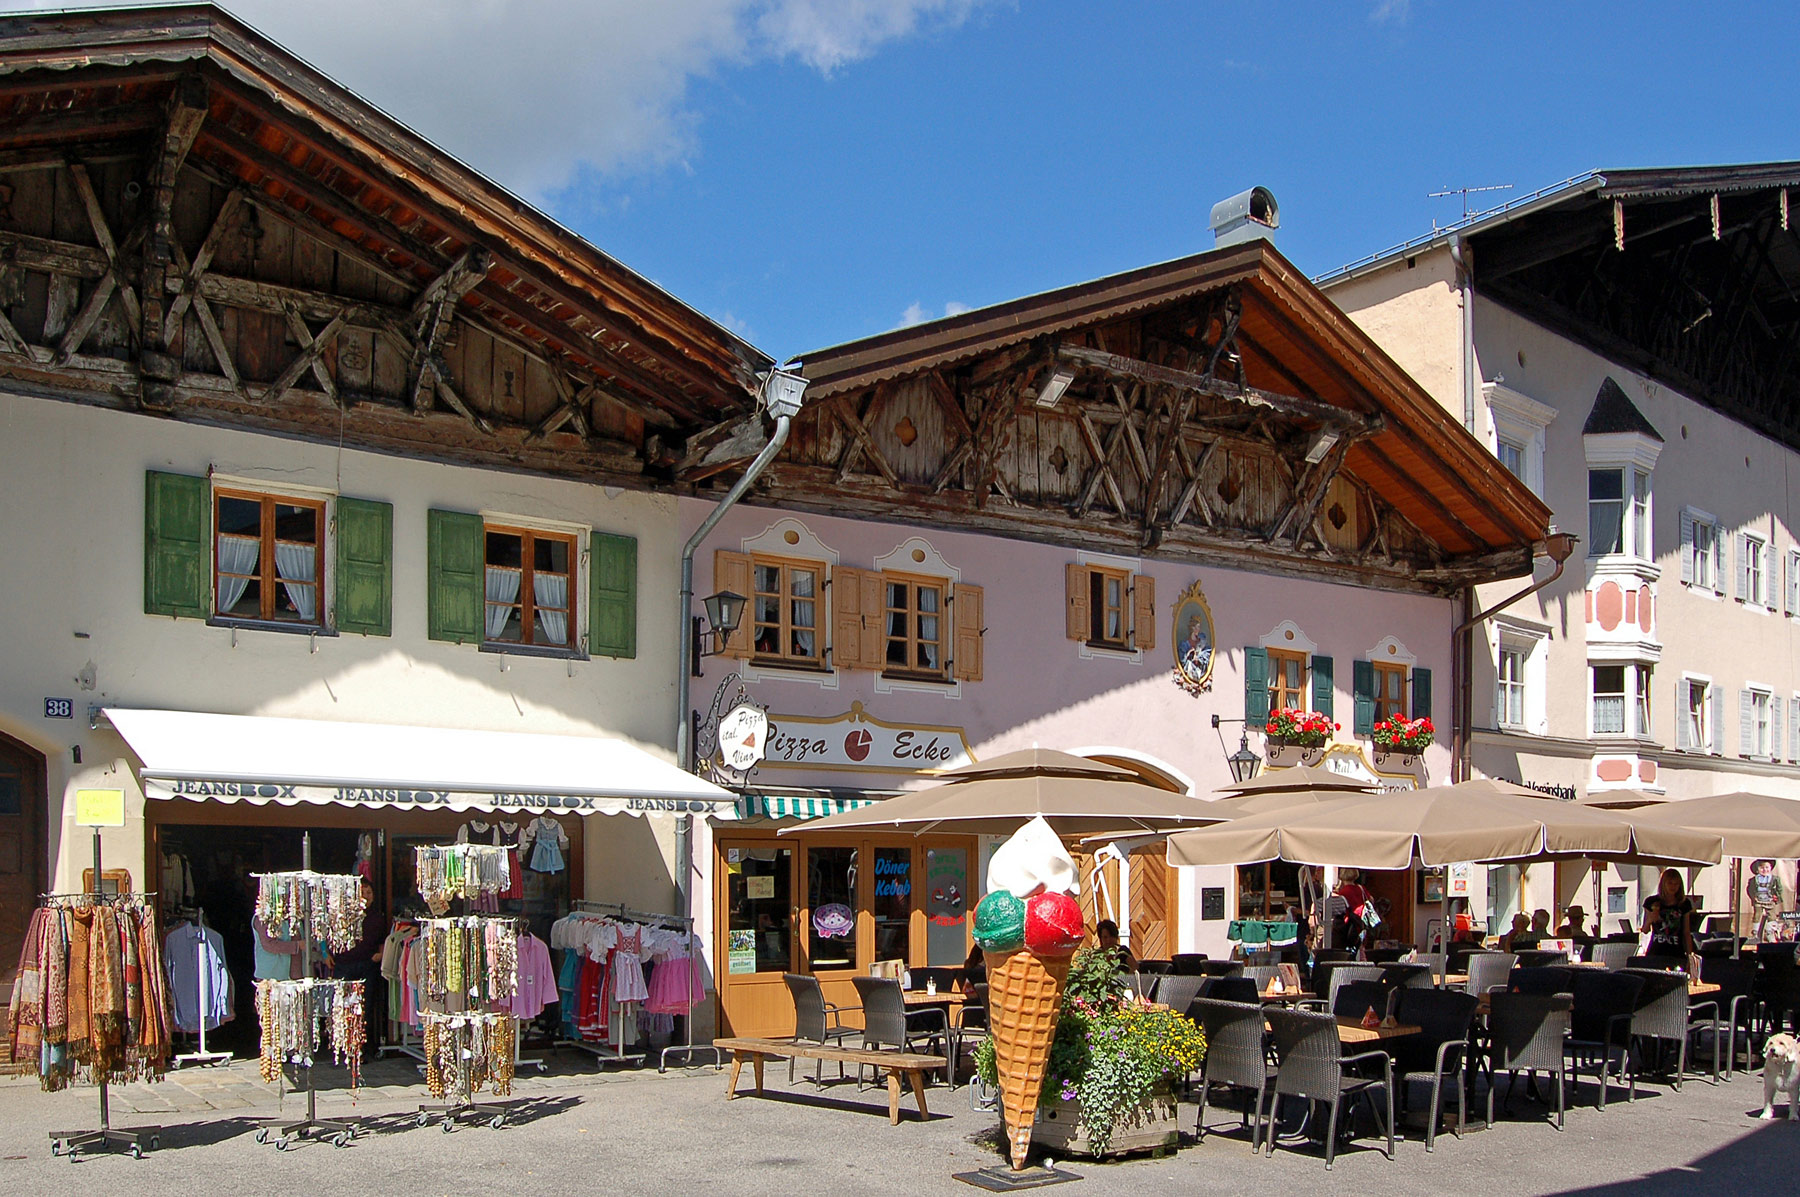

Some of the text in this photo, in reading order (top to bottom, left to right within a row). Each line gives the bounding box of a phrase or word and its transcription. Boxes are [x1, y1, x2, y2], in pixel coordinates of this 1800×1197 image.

[47, 700, 70, 716] 38
[738, 710, 764, 729] Pizza
[892, 731, 951, 760] Ecke
[732, 749, 754, 764] Vino
[172, 780, 717, 813] JEANSBOX JEANSBOX JEANSBOX JEANSBOX
[875, 857, 910, 875] Döner
[875, 879, 911, 896] Kebab
[1653, 934, 1679, 945] PEACE
